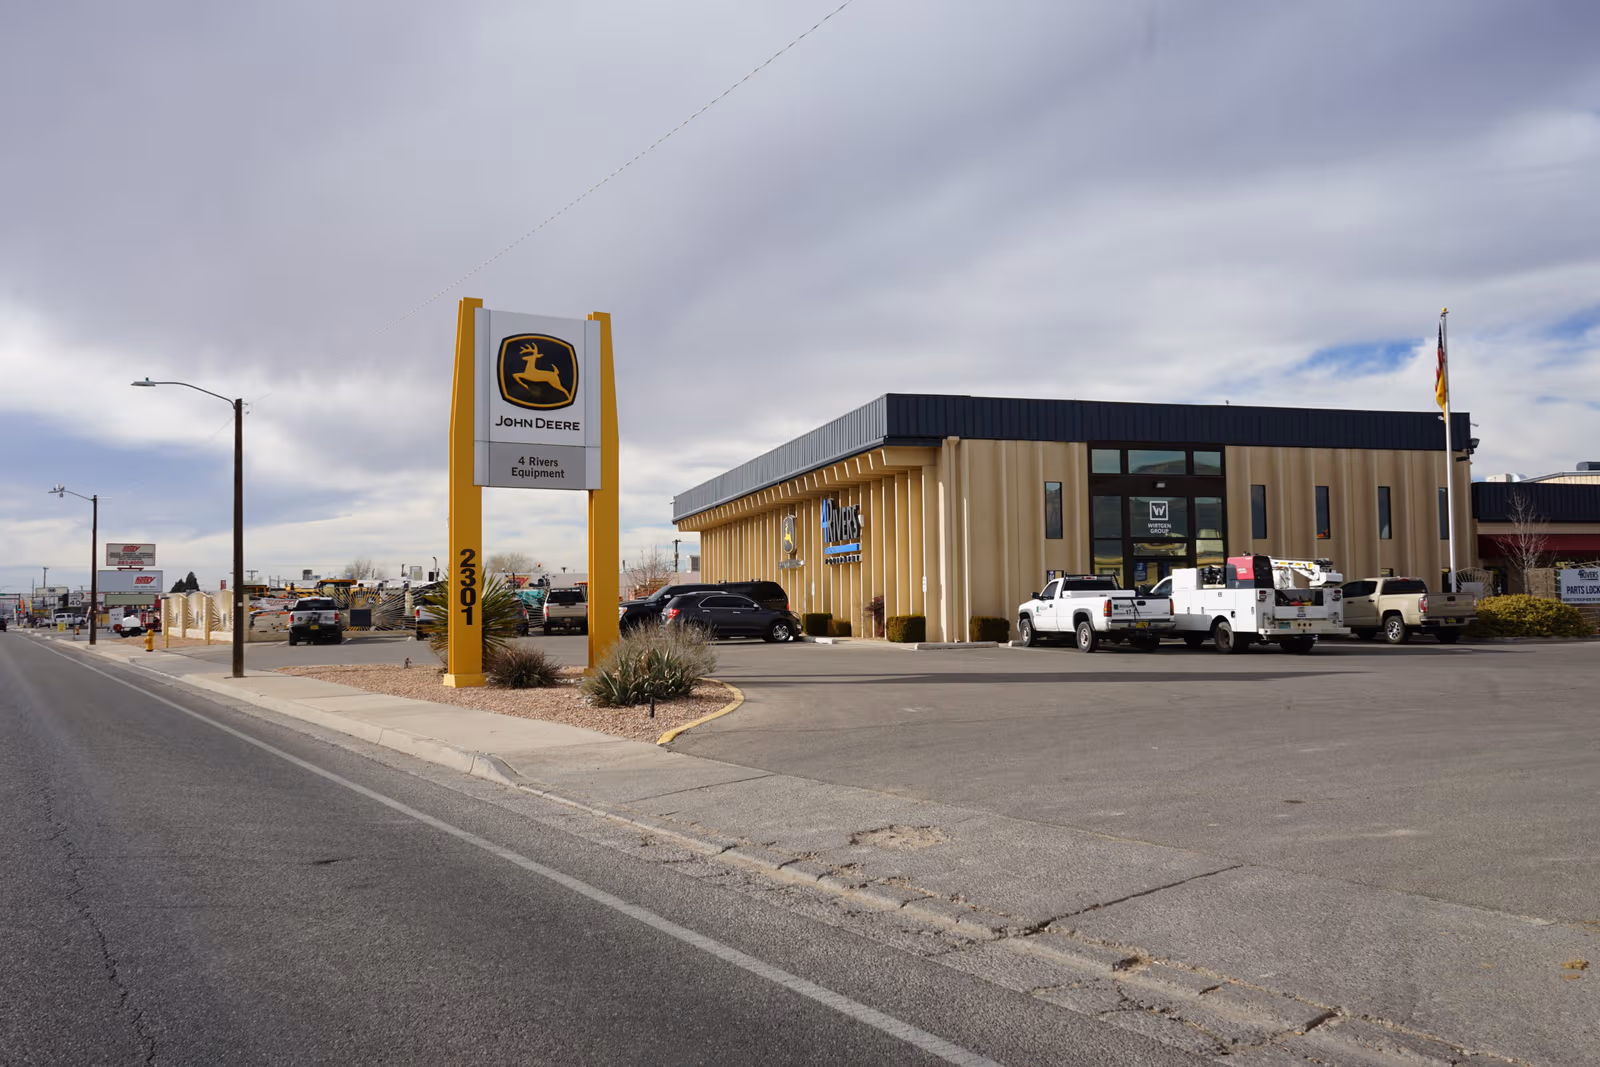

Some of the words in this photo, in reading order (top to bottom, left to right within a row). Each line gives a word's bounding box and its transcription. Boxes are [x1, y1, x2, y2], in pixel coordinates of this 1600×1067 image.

[518, 456, 525, 466] 4
[529, 457, 559, 468] Rivers
[511, 467, 565, 479] Equipment
[460, 548, 476, 626] 2301
[1566, 585, 1585, 595] PARTS
